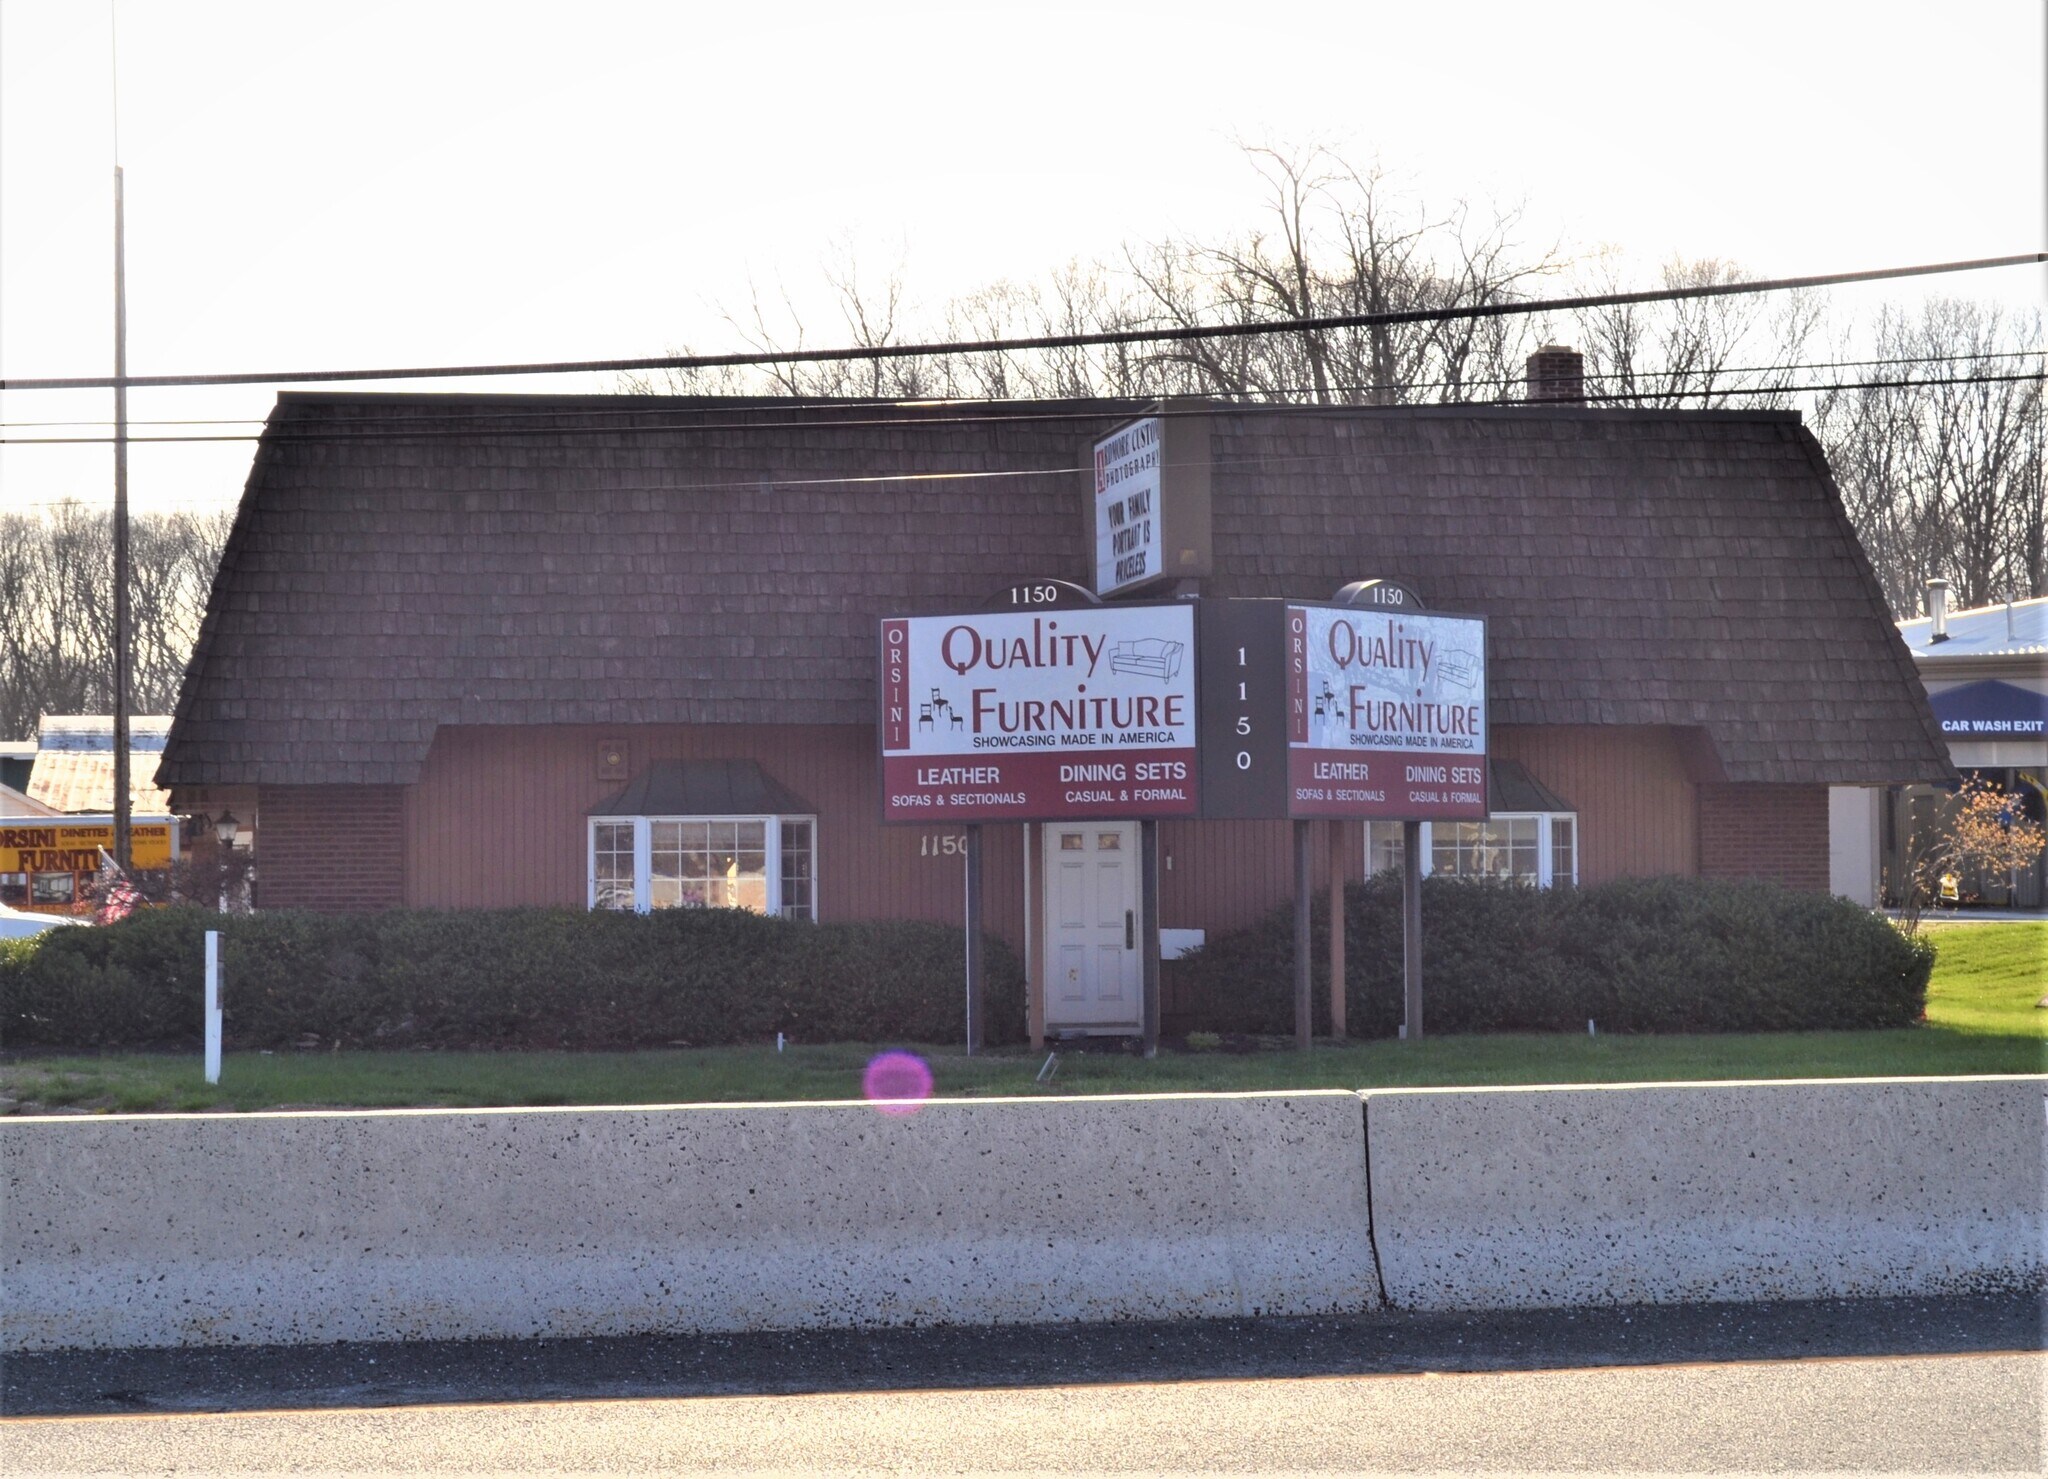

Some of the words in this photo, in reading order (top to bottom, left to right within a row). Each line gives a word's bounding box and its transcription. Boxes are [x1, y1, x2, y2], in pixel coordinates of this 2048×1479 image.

[1128, 488, 1151, 521] FAMILY
[1112, 522, 1141, 557] PORTRAIT
[1143, 519, 1151, 544] IS
[1115, 550, 1147, 584] PRICELESS
[1010, 585, 1057, 604] 1150
[1372, 587, 1403, 605] 1150
[1291, 617, 1304, 734] ORSINI
[888, 629, 903, 742] ORSINI
[1942, 720, 1970, 732] CAR
[1972, 720, 2011, 732] WASH
[2013, 720, 2044, 732] EXIT
[973, 734, 1056, 748] SHOWCASING
[1061, 732, 1096, 745] MADE
[1101, 732, 1114, 745] IN
[1119, 731, 1175, 744] AMERICA
[1350, 733, 1403, 747] SHOWCASING
[1405, 735, 1428, 747] MADE
[1430, 736, 1438, 748] IN
[1440, 737, 1474, 750] AMERICA
[917, 766, 1000, 786] LEATHER
[1060, 764, 1127, 783] DINING
[1135, 761, 1187, 780] SETS
[1313, 762, 1369, 781] LEATHER
[1406, 765, 1447, 784] DINING
[1451, 766, 1482, 785] SETS
[892, 794, 931, 807] SOFAS
[936, 794, 945, 806] &
[950, 791, 1026, 805] SECTIONALS
[1065, 789, 1115, 803] CASUAL
[1120, 789, 1129, 801] &
[1134, 787, 1187, 801] FORMAL
[1296, 788, 1324, 801] SOFAS
[1326, 789, 1333, 801] &
[1335, 788, 1385, 802] SECTIONALS
[1409, 791, 1440, 803] CASUAL
[1442, 792, 1448, 803] &
[1450, 791, 1481, 804] FORMAL
[0, 828, 56, 849] RSINI
[60, 827, 108, 838] DINETTES
